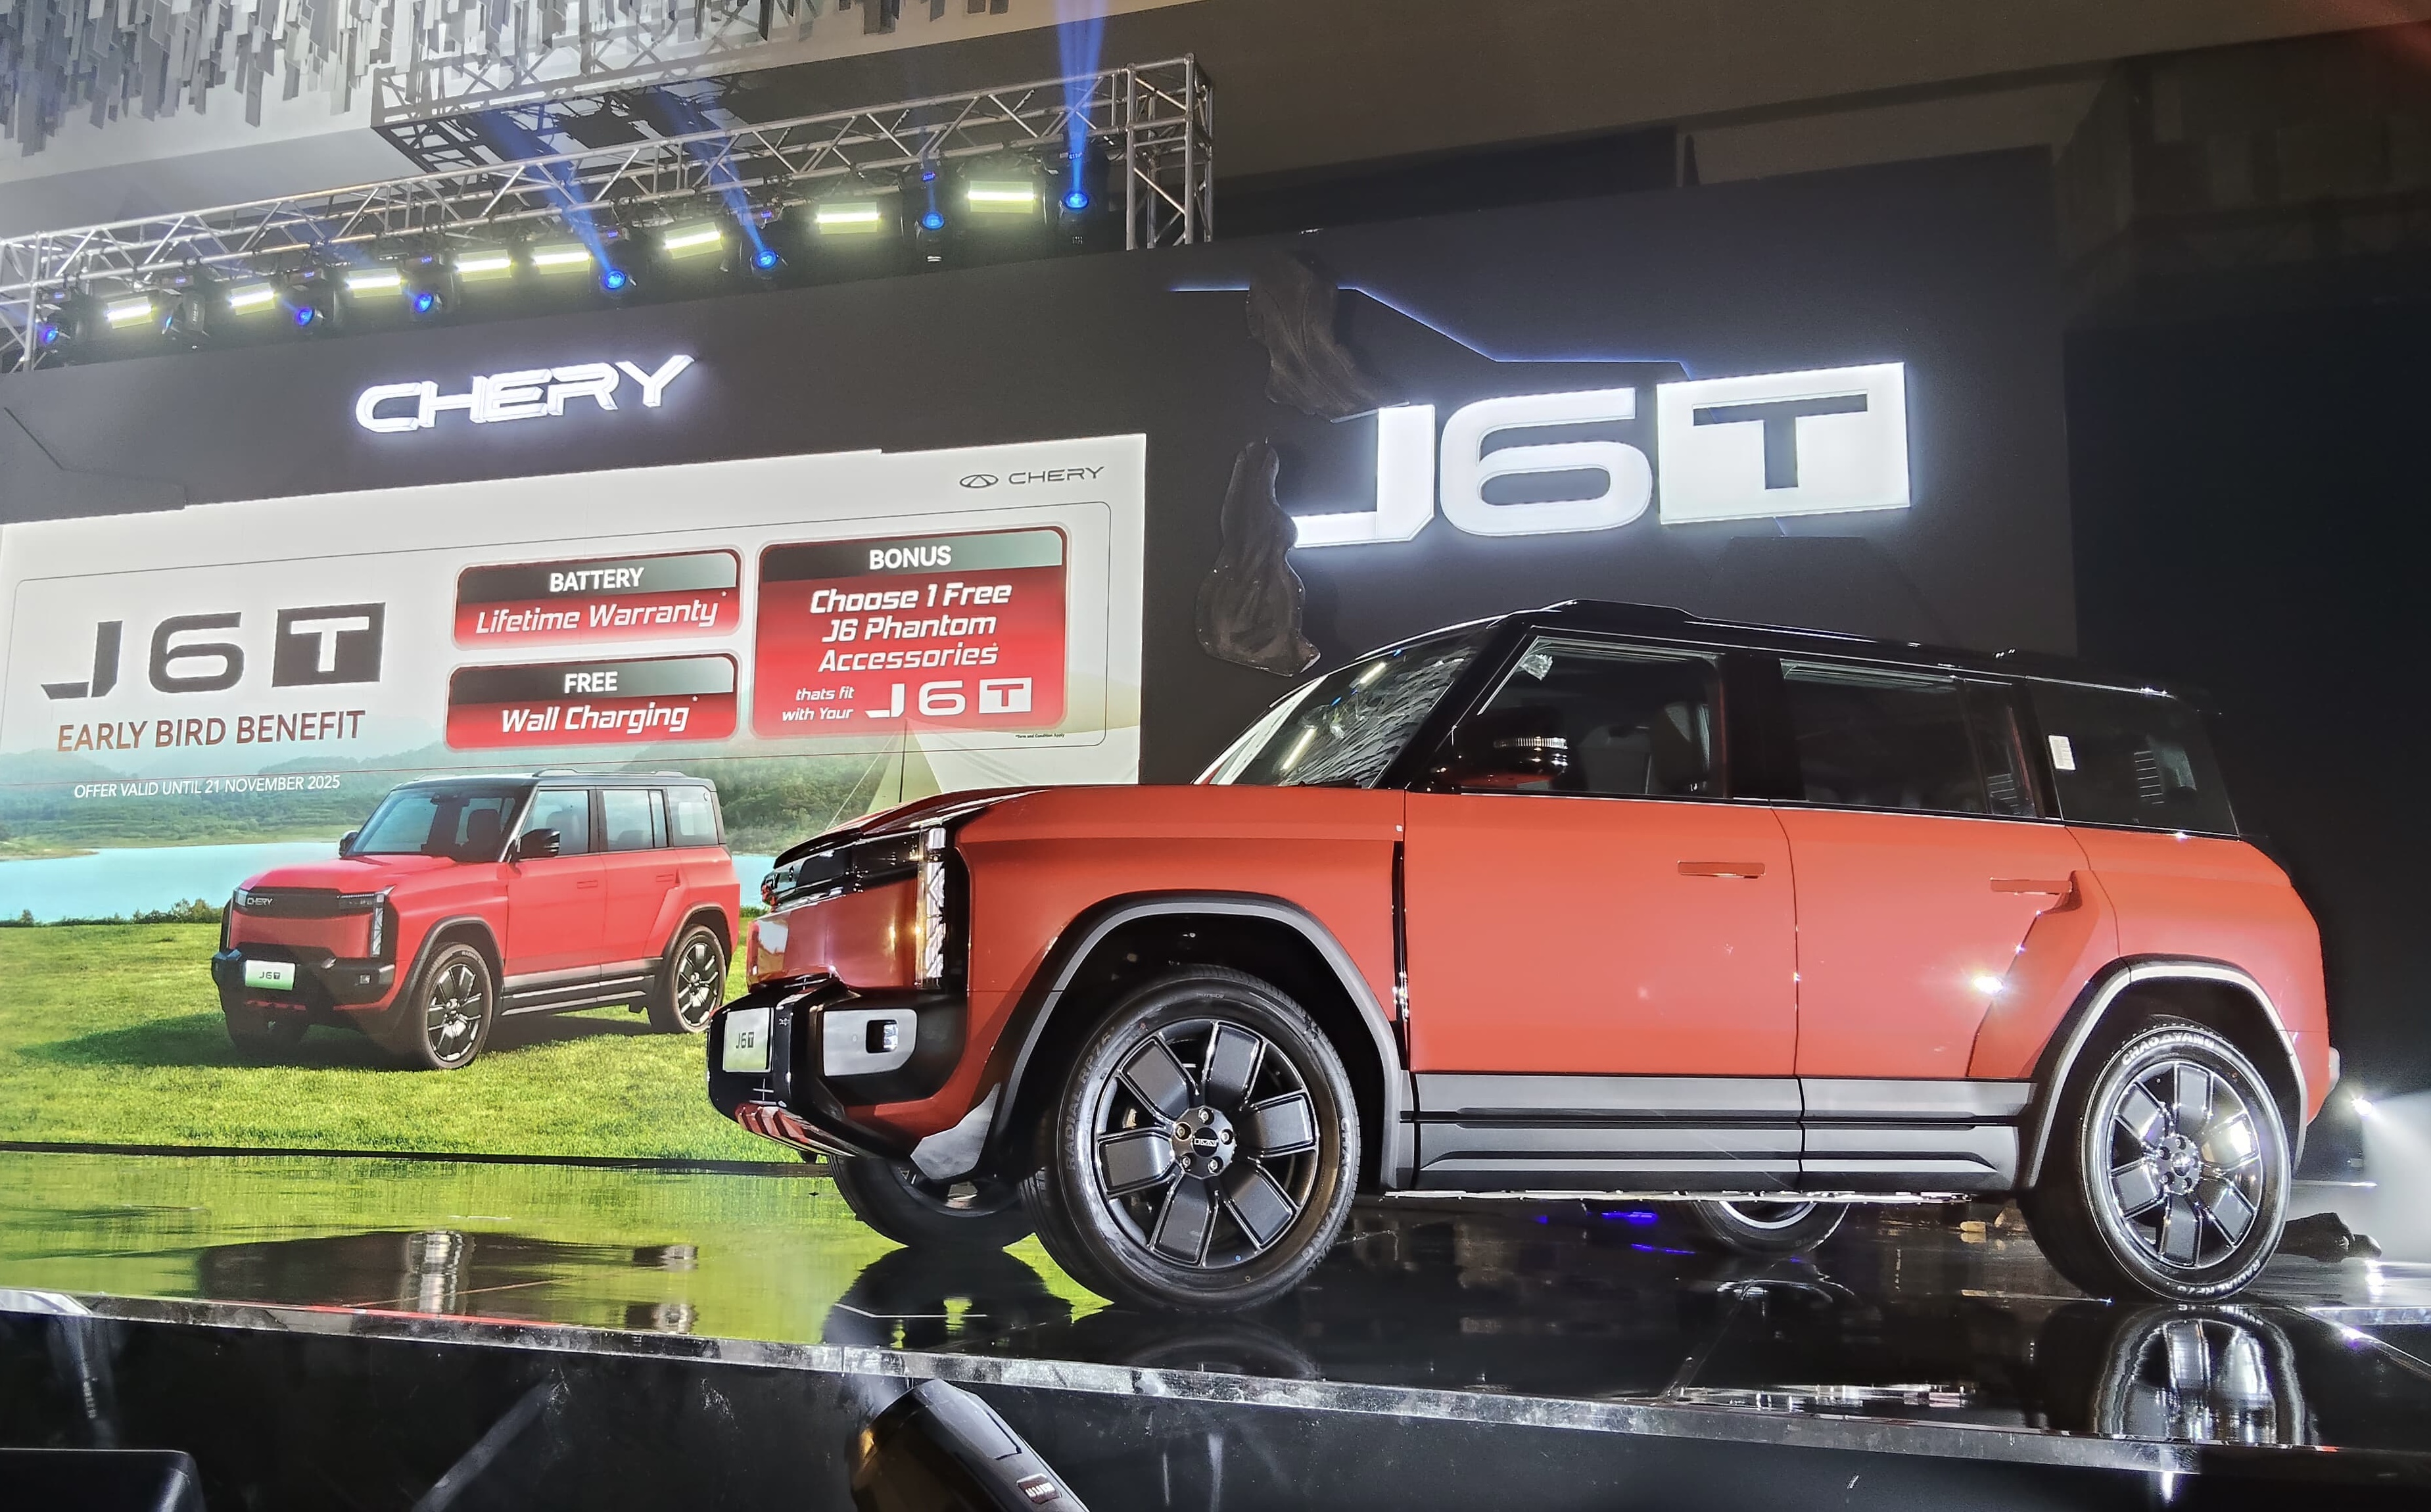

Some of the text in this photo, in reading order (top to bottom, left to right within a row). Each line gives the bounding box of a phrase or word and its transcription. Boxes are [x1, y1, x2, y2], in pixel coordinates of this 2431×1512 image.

[356, 354, 695, 433] CHERY
[1008, 466, 1104, 485] CHERY
[869, 545, 952, 570] BONUS
[550, 567, 644, 592] BATTERY
[809, 582, 1012, 614] Choose 1 Free
[475, 599, 719, 634] Lifetime Warranty
[822, 615, 997, 643] J6 Phantom
[41, 602, 386, 700] J6T
[818, 642, 999, 673] Accessories
[564, 671, 618, 694] FREE
[795, 686, 855, 701] thats fit
[864, 677, 1032, 718] J6T
[502, 702, 690, 734] Wall Charging
[782, 707, 854, 722] with Your
[57, 710, 366, 752] EARLY BIRD BENEFIT
[74, 774, 341, 798] OFFER VALID UNTIL 21 NOVEMBER 2025
[247, 897, 273, 906] CHERY
